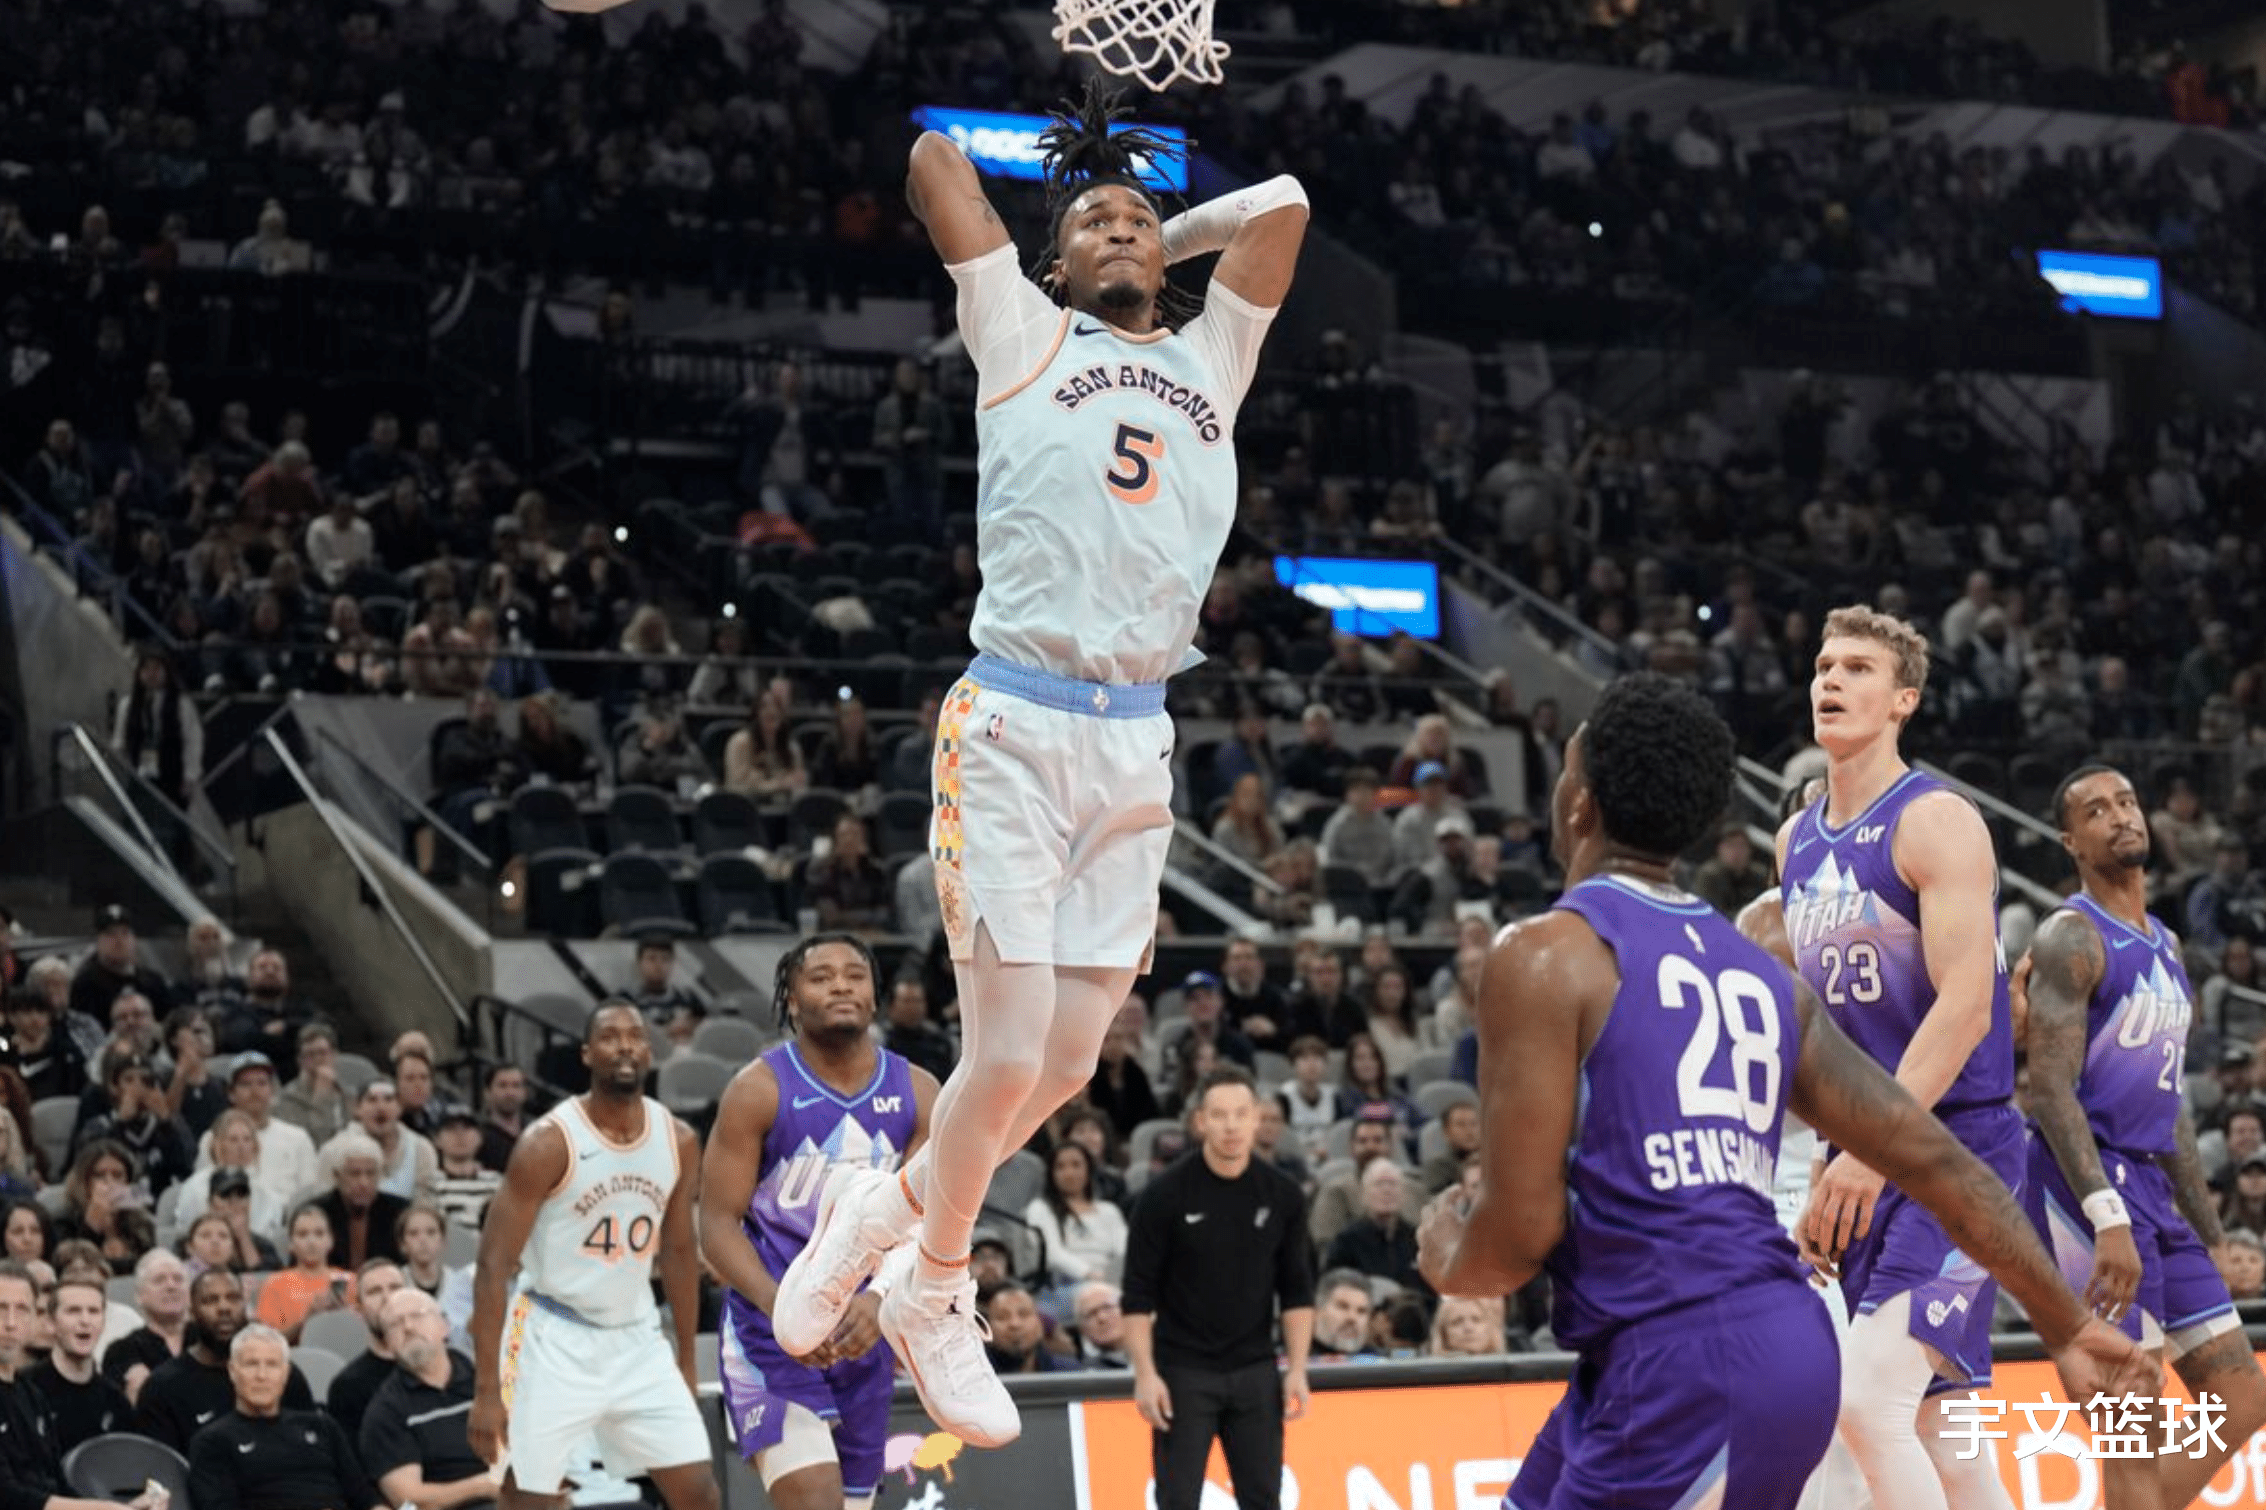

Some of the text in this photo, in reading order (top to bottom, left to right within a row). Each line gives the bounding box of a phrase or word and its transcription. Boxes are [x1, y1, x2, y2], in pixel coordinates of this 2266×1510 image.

[1054, 365, 1221, 443] SAN ANTONIO
[1106, 422, 1163, 500] 5
[1819, 942, 1882, 1004] 23
[1657, 953, 1781, 1134] 28
[582, 1214, 656, 1258] 40
